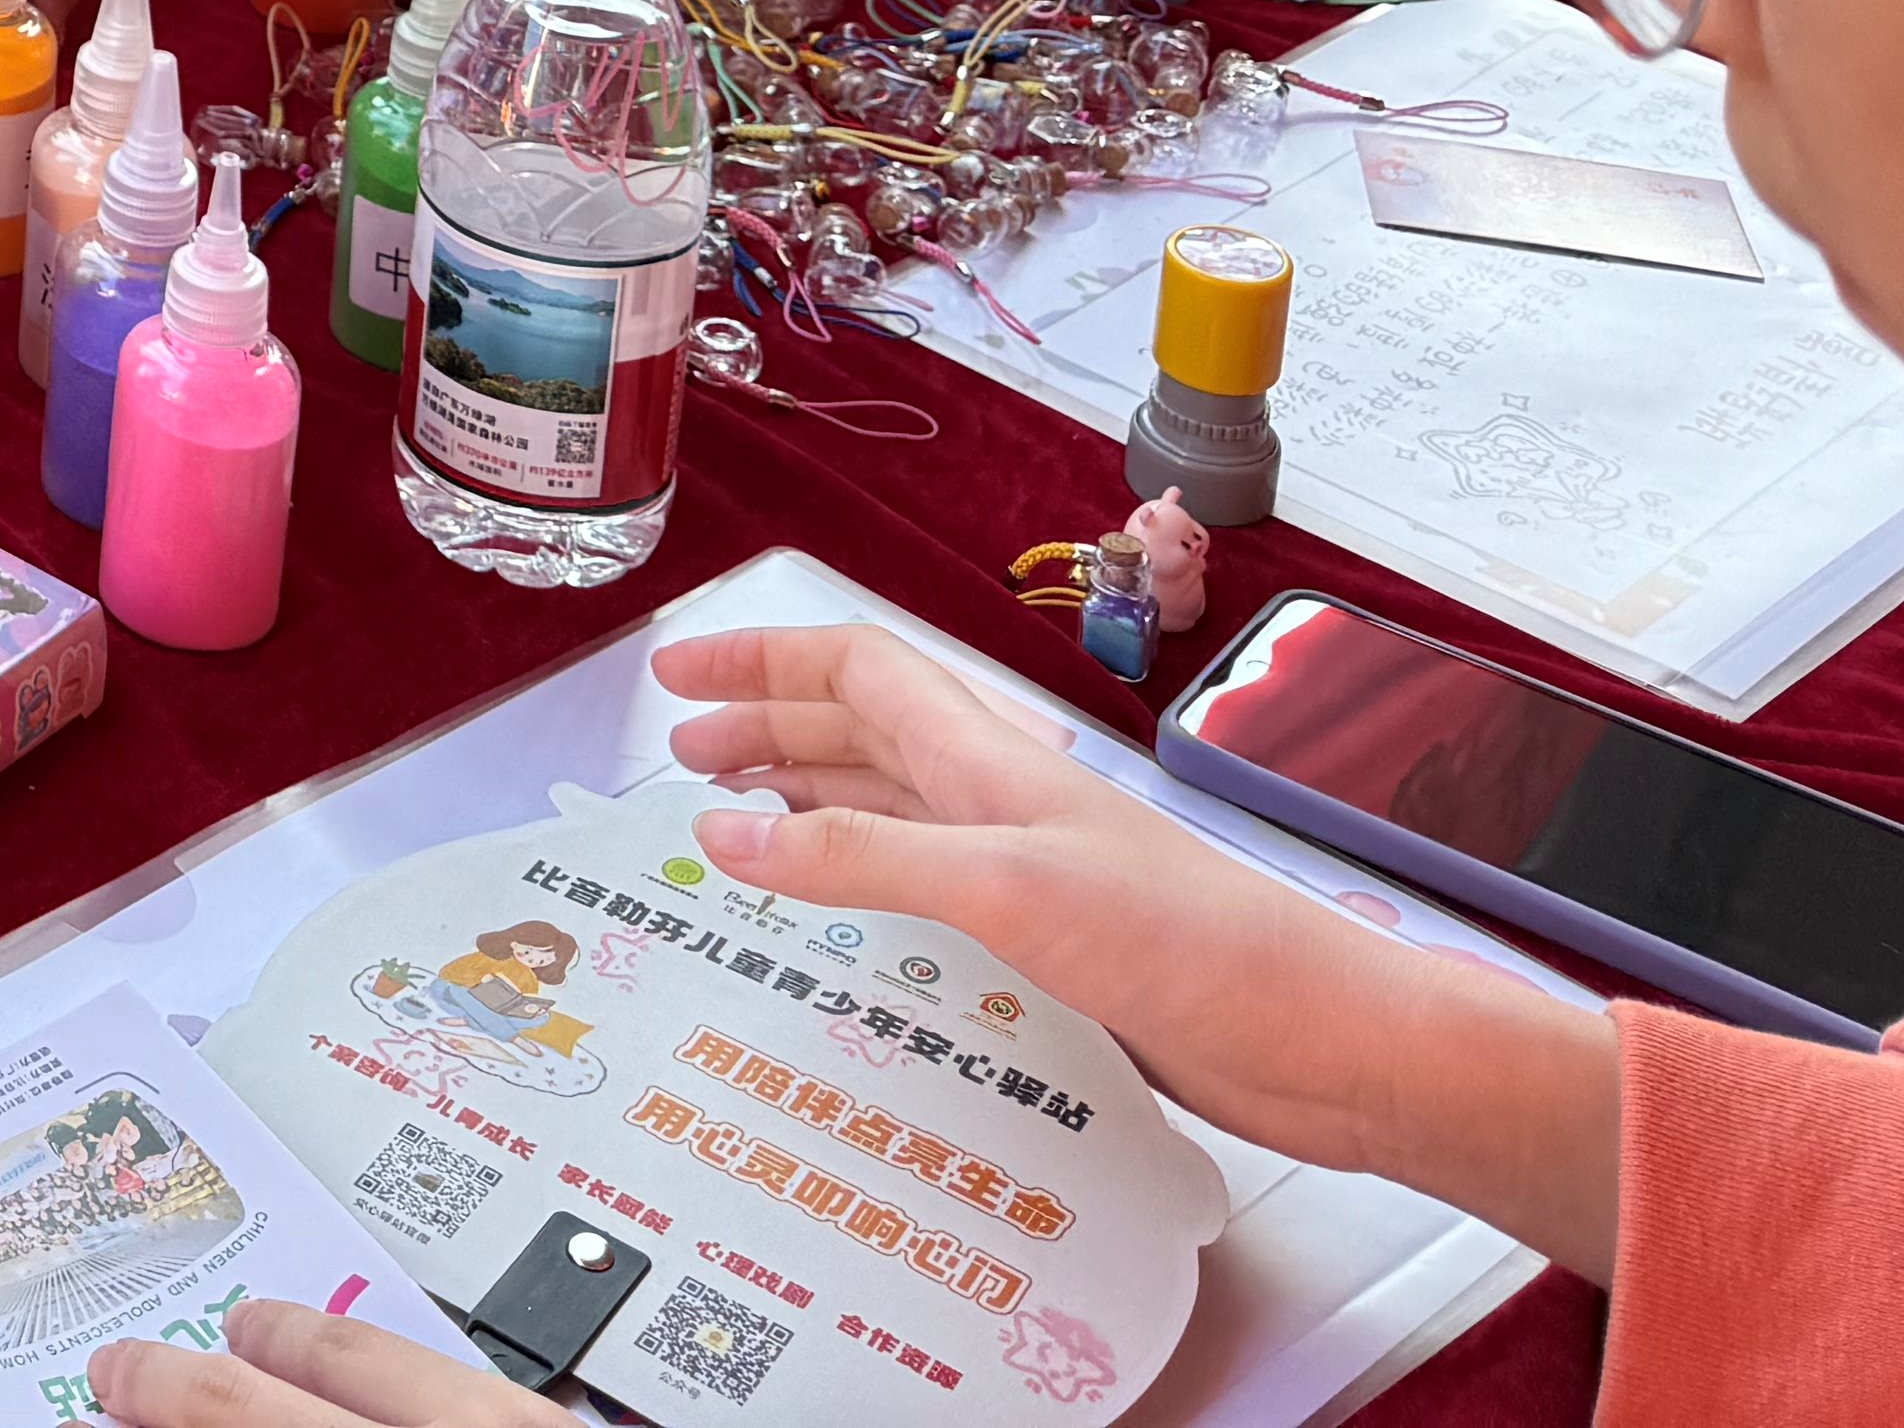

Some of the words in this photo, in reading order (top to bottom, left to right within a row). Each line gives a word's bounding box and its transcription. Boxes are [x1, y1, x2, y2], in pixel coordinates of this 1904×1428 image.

[375, 248, 410, 291] 中
[522, 859, 1095, 1133] 比音勒芬儿童青少年安心驿站
[678, 1028, 1070, 1238] 用陪伴点亮生命
[632, 1089, 1024, 1310] 用心灵叩响心门
[203, 1210, 269, 1275] CHILDREN
[696, 1240, 815, 1310] 心理戏剧
[167, 1270, 200, 1298] AND
[45, 1293, 163, 1357] ADOLESCENTS
[835, 1311, 965, 1391] 合作资源
